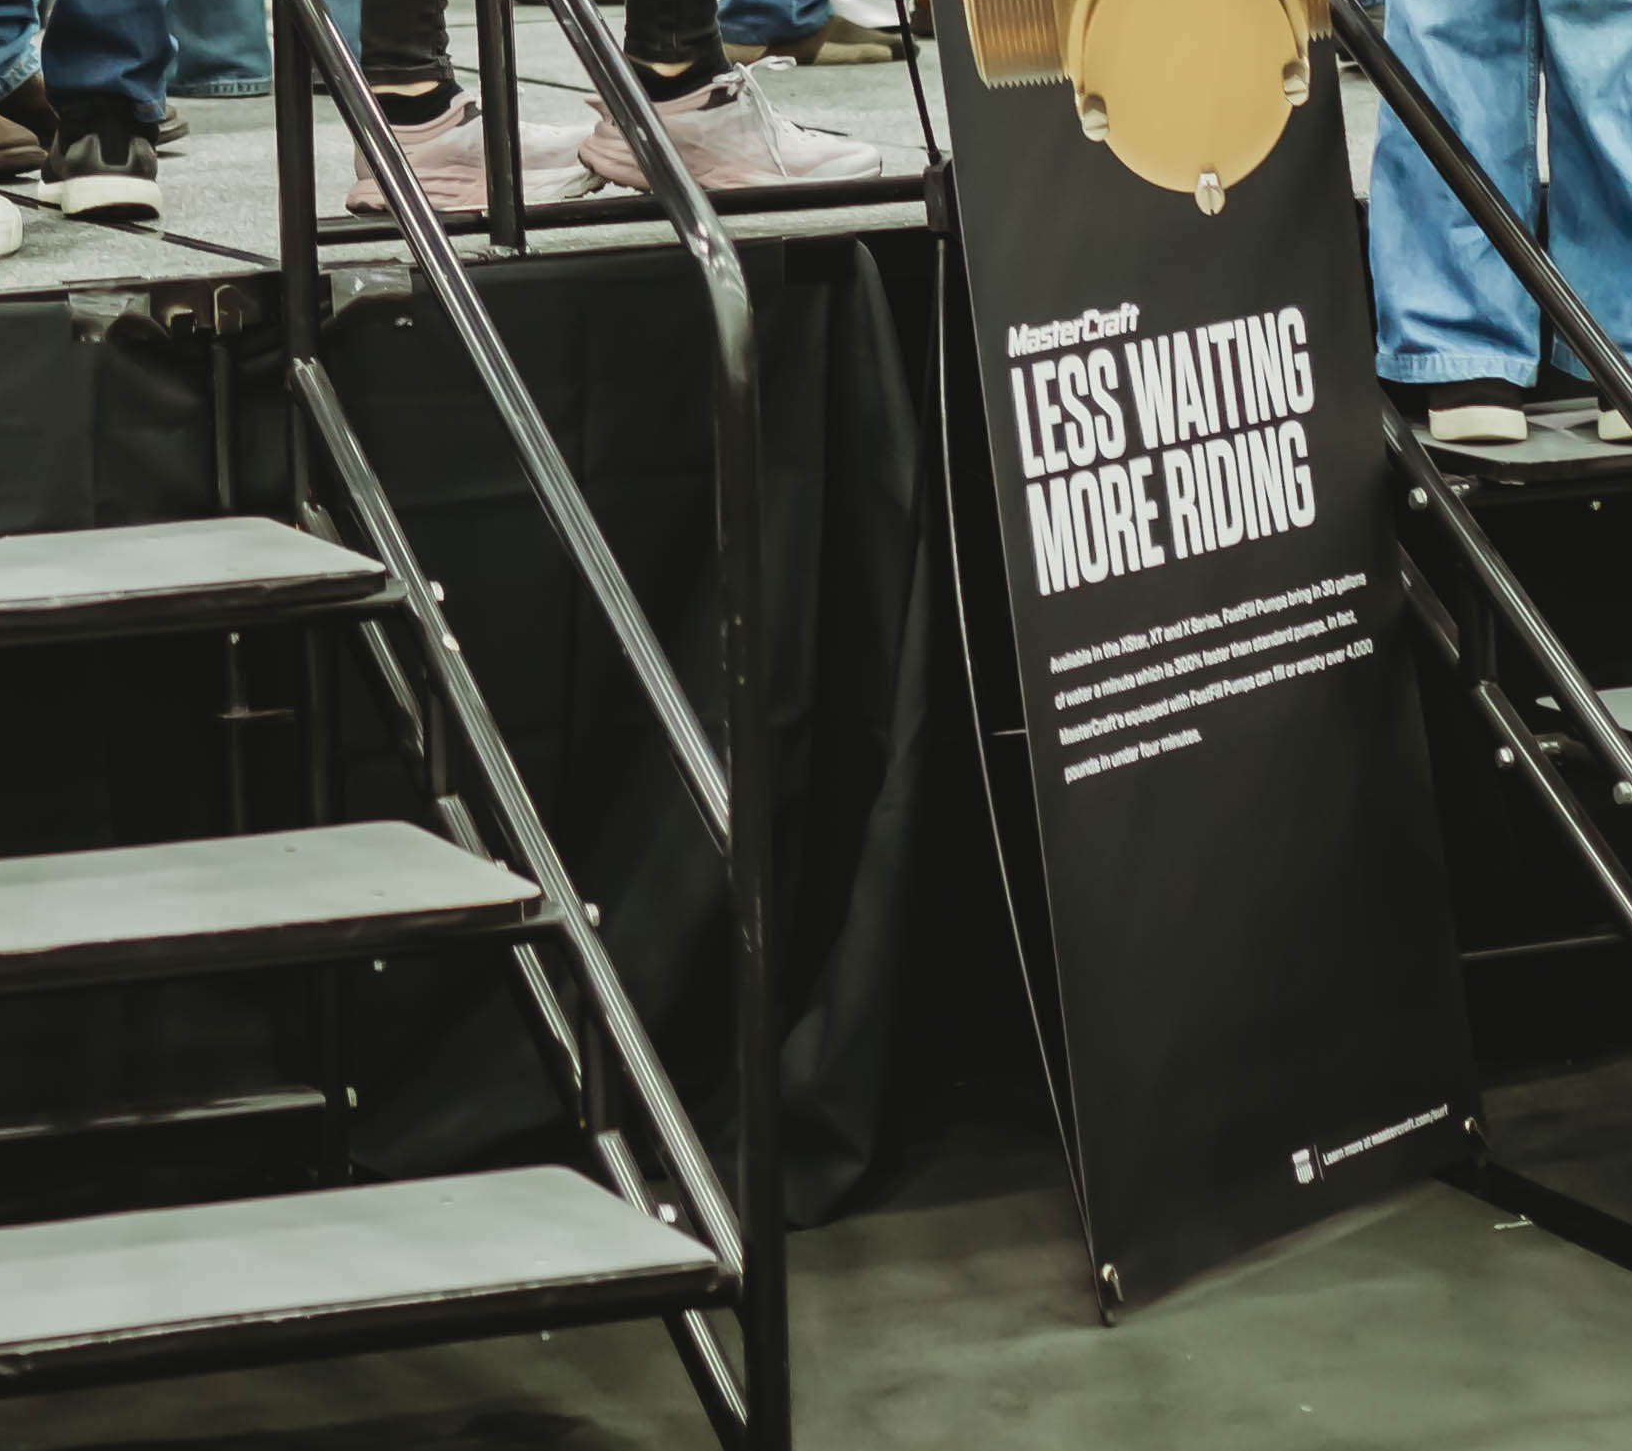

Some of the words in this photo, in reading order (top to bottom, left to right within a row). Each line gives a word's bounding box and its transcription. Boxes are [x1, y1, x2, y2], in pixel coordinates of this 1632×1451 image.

[1007, 302, 1140, 358] MasterCraft
[1010, 348, 1127, 479] LESS
[1124, 306, 1315, 449] WAITING
[1026, 456, 1166, 596] MORE
[1163, 420, 1316, 559] RIDING
[1050, 649, 1093, 674] Available
[1091, 645, 1103, 662] in
[1102, 640, 1121, 659] the
[1148, 626, 1163, 646] XT
[1163, 620, 1183, 642] and
[1182, 617, 1192, 636] X
[1255, 595, 1288, 615] Pumps
[1286, 588, 1313, 606] bring
[1311, 583, 1322, 600] in
[1335, 573, 1367, 596] gallons
[1054, 691, 1066, 710] of
[1065, 685, 1093, 708] water
[1093, 683, 1102, 699] a
[1101, 673, 1136, 697] minute
[1134, 664, 1165, 687] which
[1163, 661, 1174, 678] is
[1202, 646, 1230, 667] faster
[1229, 640, 1254, 658] than
[1251, 626, 1294, 653] standard
[1125, 698, 1170, 727] equipped
[1168, 693, 1191, 714] with
[1222, 675, 1256, 697] Pumps
[1254, 669, 1274, 687] can
[1272, 663, 1286, 681] fill
[1285, 663, 1296, 678] or
[1296, 654, 1325, 675] empty
[1325, 648, 1346, 666] over
[1064, 757, 1101, 785] pounds
[1099, 753, 1112, 771] in
[1110, 746, 1140, 768] under
[1139, 741, 1161, 758] four
[1322, 1147, 1345, 1166] Learn
